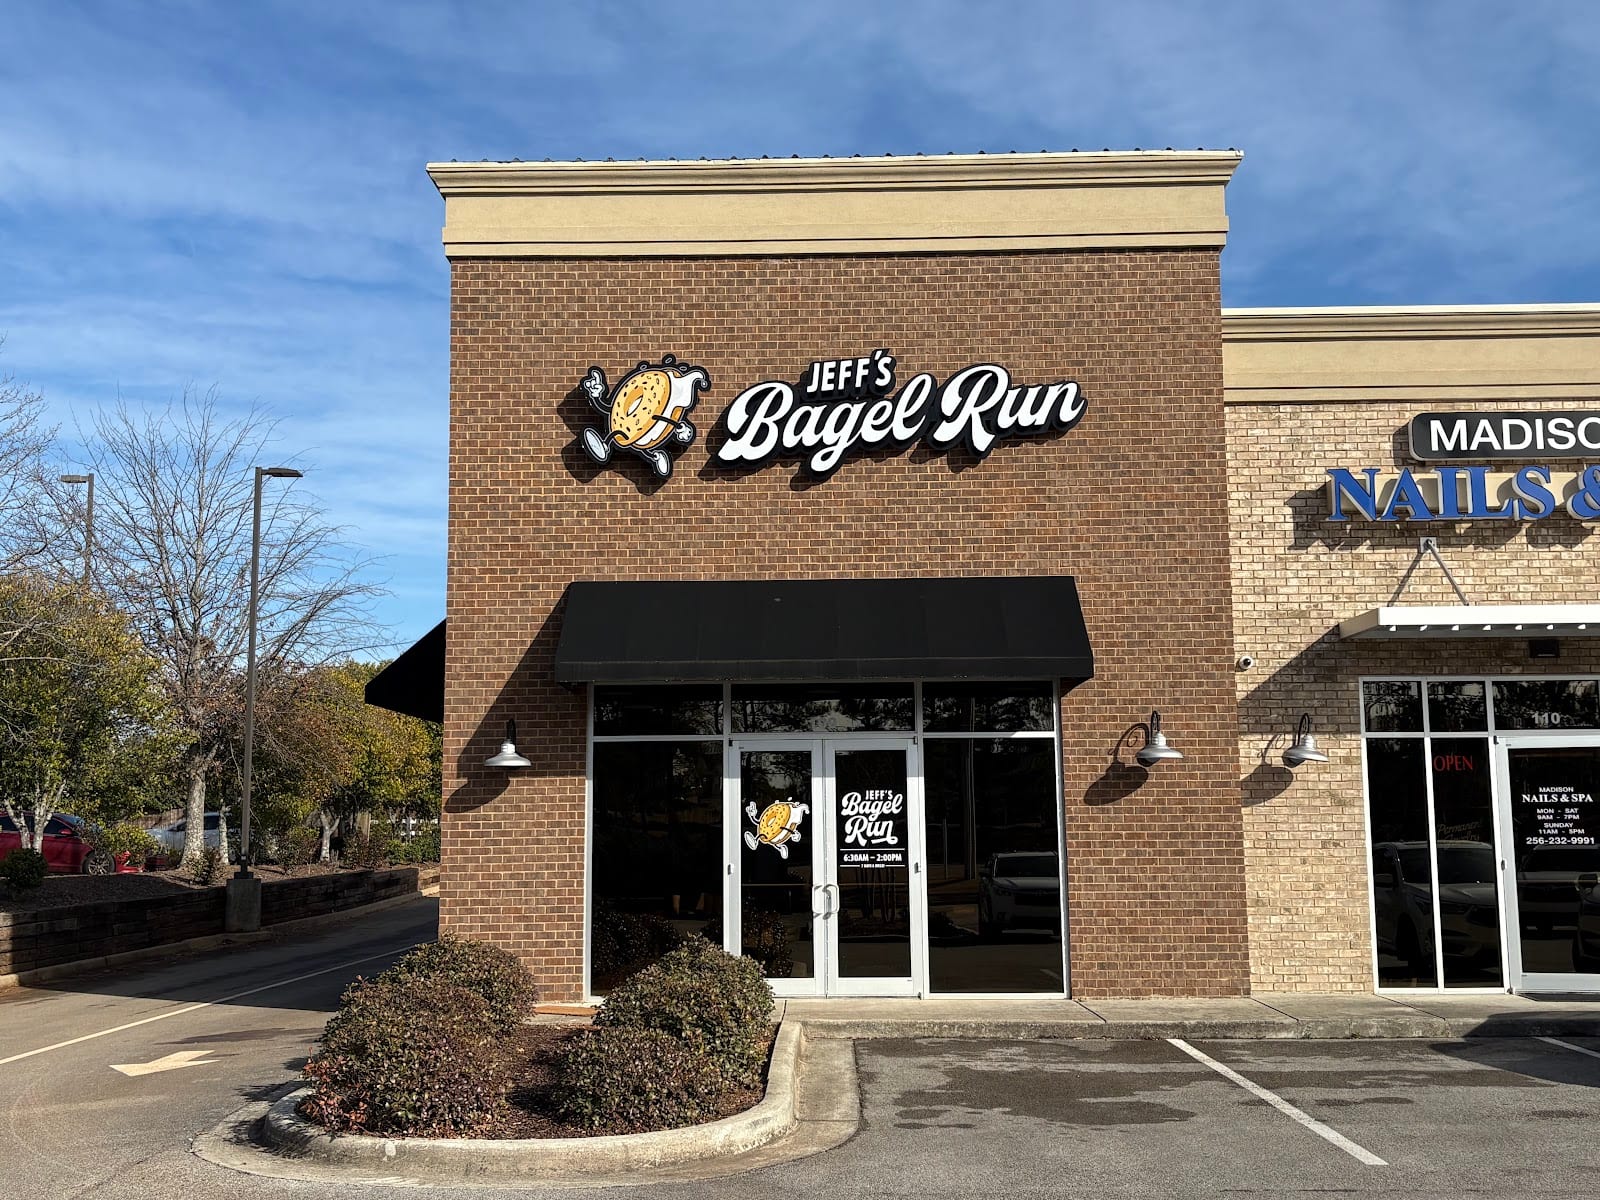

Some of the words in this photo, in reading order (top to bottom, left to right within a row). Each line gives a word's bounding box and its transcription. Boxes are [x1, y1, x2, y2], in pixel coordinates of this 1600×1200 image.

[806, 350, 892, 393] JEFF'S
[718, 373, 934, 472] Bagel
[934, 364, 1085, 452] Run
[1327, 465, 1556, 521] NAILS
[1531, 711, 1560, 724] 110
[1433, 754, 1474, 772] OPEN
[865, 790, 893, 800] JEFF'S
[1522, 794, 1558, 803] NAILS
[1560, 794, 1570, 803] &
[1571, 794, 1593, 803] SPA
[841, 792, 903, 822] Bagel
[845, 816, 899, 847] Run
[1526, 837, 1595, 845] 256-232-9991
[843, 853, 869, 861] 6:30AM
[876, 853, 902, 861] 2:00PM
